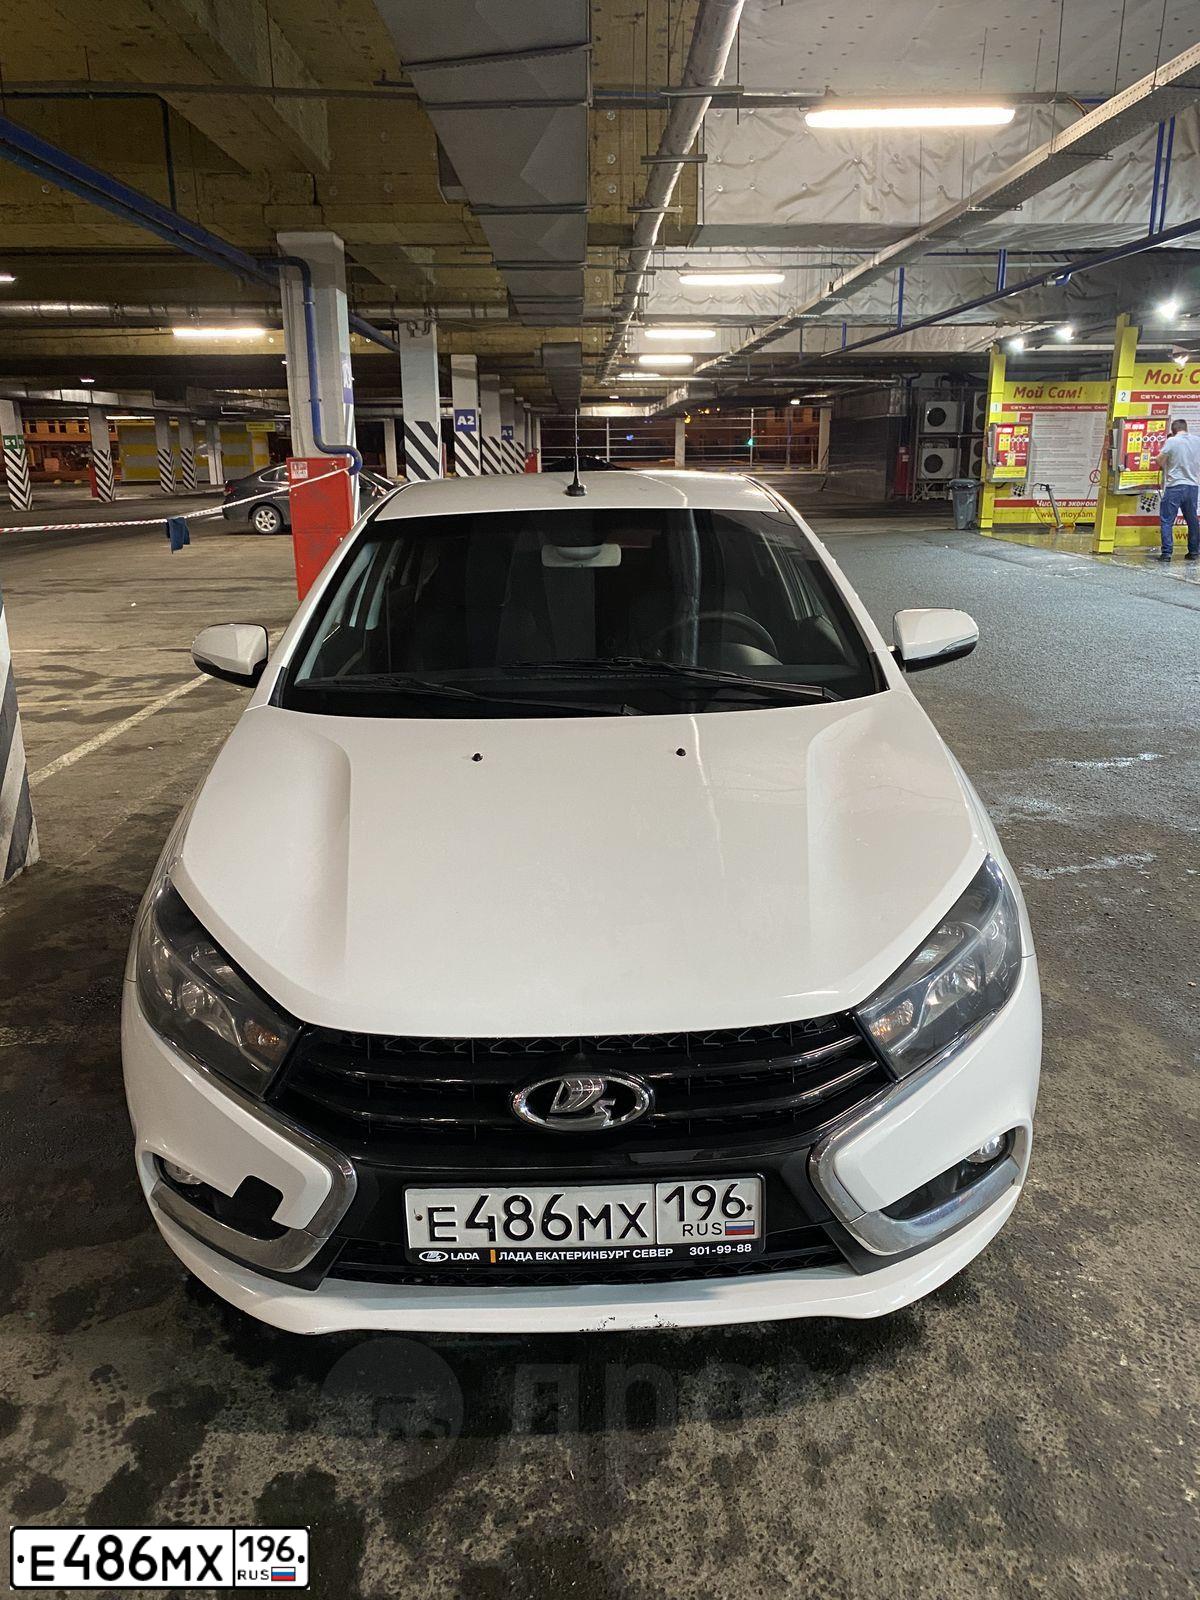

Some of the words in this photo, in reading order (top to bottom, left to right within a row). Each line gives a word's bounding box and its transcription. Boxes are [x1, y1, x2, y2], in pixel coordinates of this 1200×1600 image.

[1143, 367, 1185, 385] Мой
[1013, 385, 1043, 399] Мой
[1048, 386, 1083, 399] Сам!
[1120, 391, 1127, 402] 2
[456, 415, 475, 426] А2
[4, 438, 16, 446] Б1
[663, 1183, 746, 1222] 196
[427, 1193, 648, 1242] Е486МХ
[682, 1222, 722, 1237] RUS
[450, 1251, 480, 1261] LADA
[498, 1251, 531, 1262] ЛАДА
[535, 1249, 631, 1262] ЕКАТЕРИНБУРГ
[632, 1248, 674, 1259] СЕВЕР
[689, 1243, 752, 1256] 301-99-88
